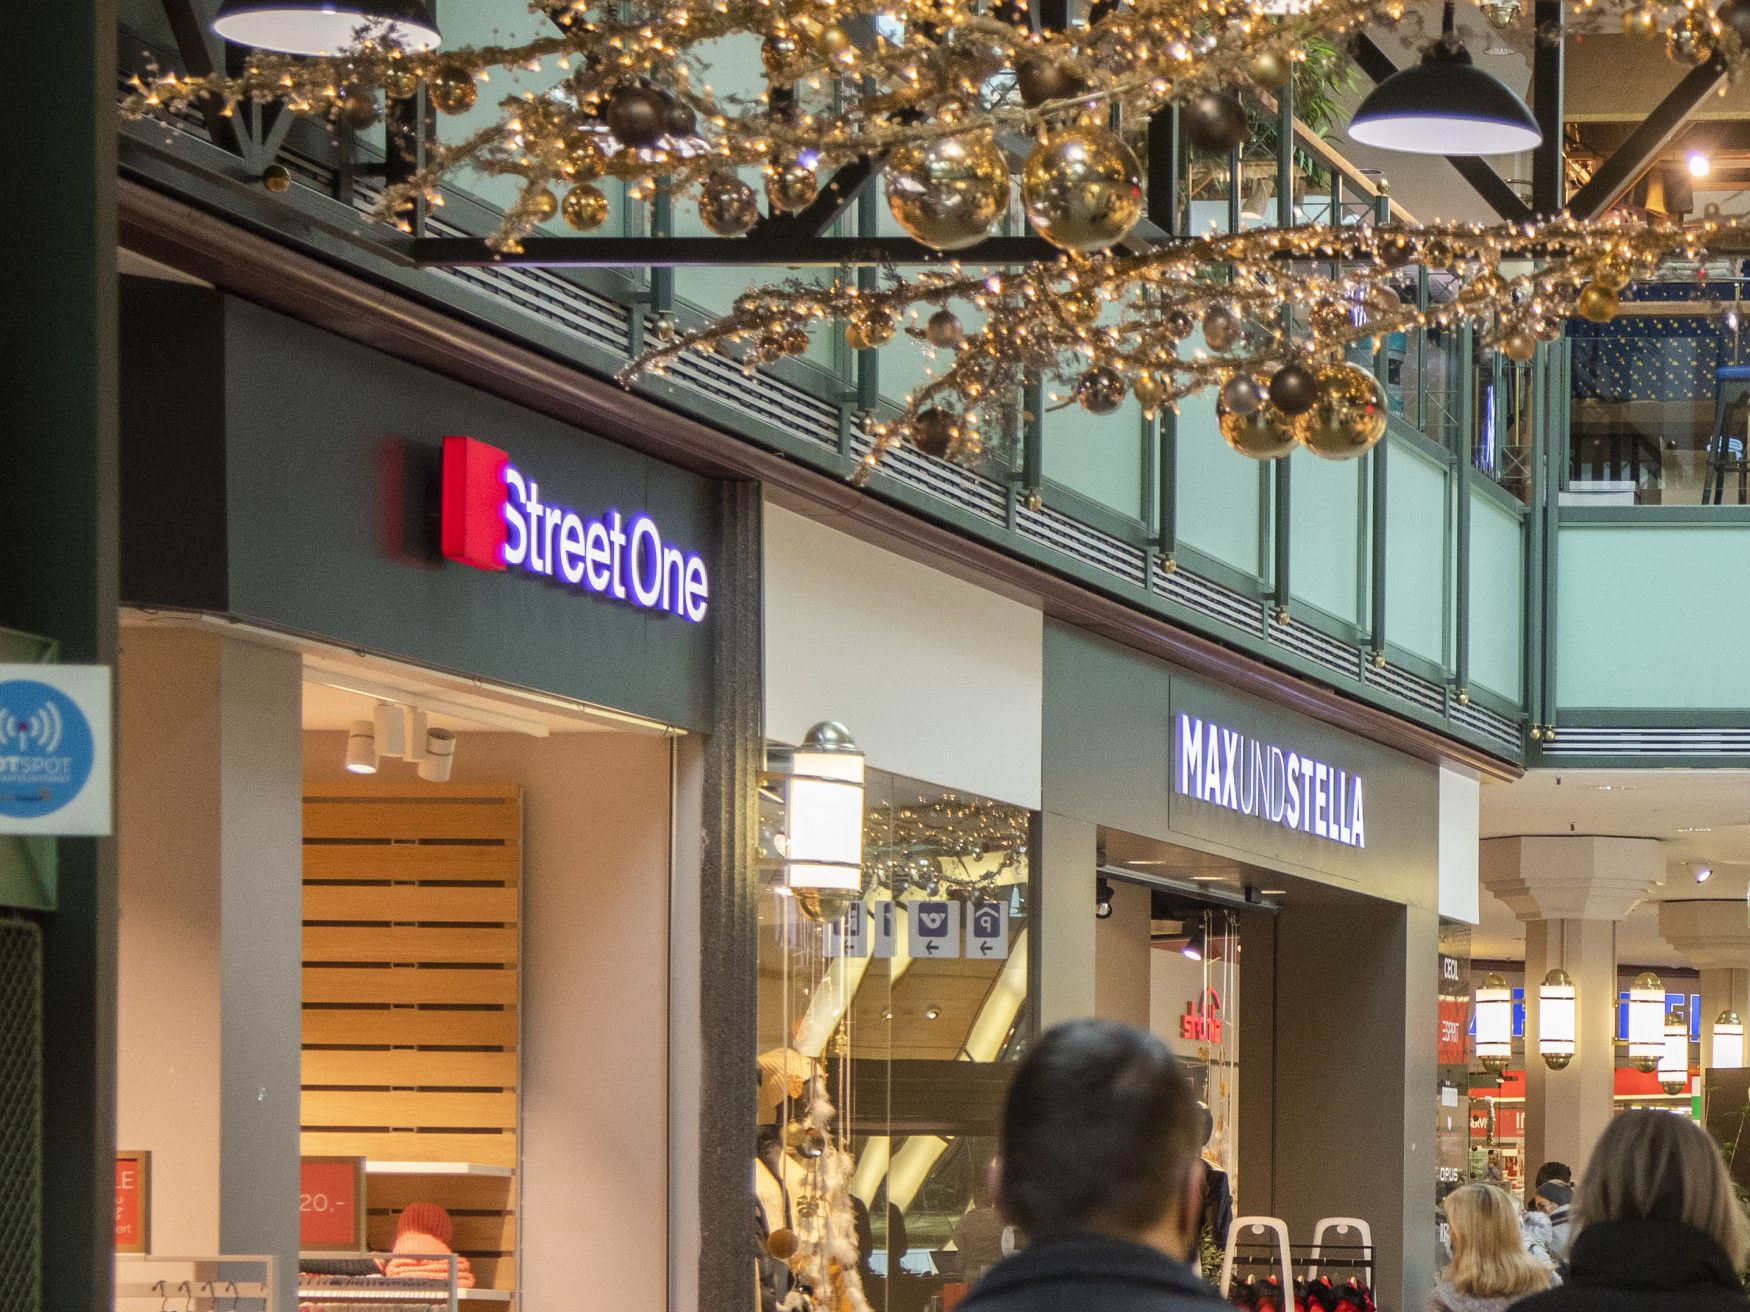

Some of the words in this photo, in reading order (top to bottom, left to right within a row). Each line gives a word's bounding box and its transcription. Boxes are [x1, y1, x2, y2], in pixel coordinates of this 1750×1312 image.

[504, 467, 626, 599] Street
[631, 517, 708, 622] One
[1444, 957, 1459, 981] CECIL
[1442, 1020, 1459, 1043] ESPRIT
[1440, 1167, 1458, 1182] OPUS
